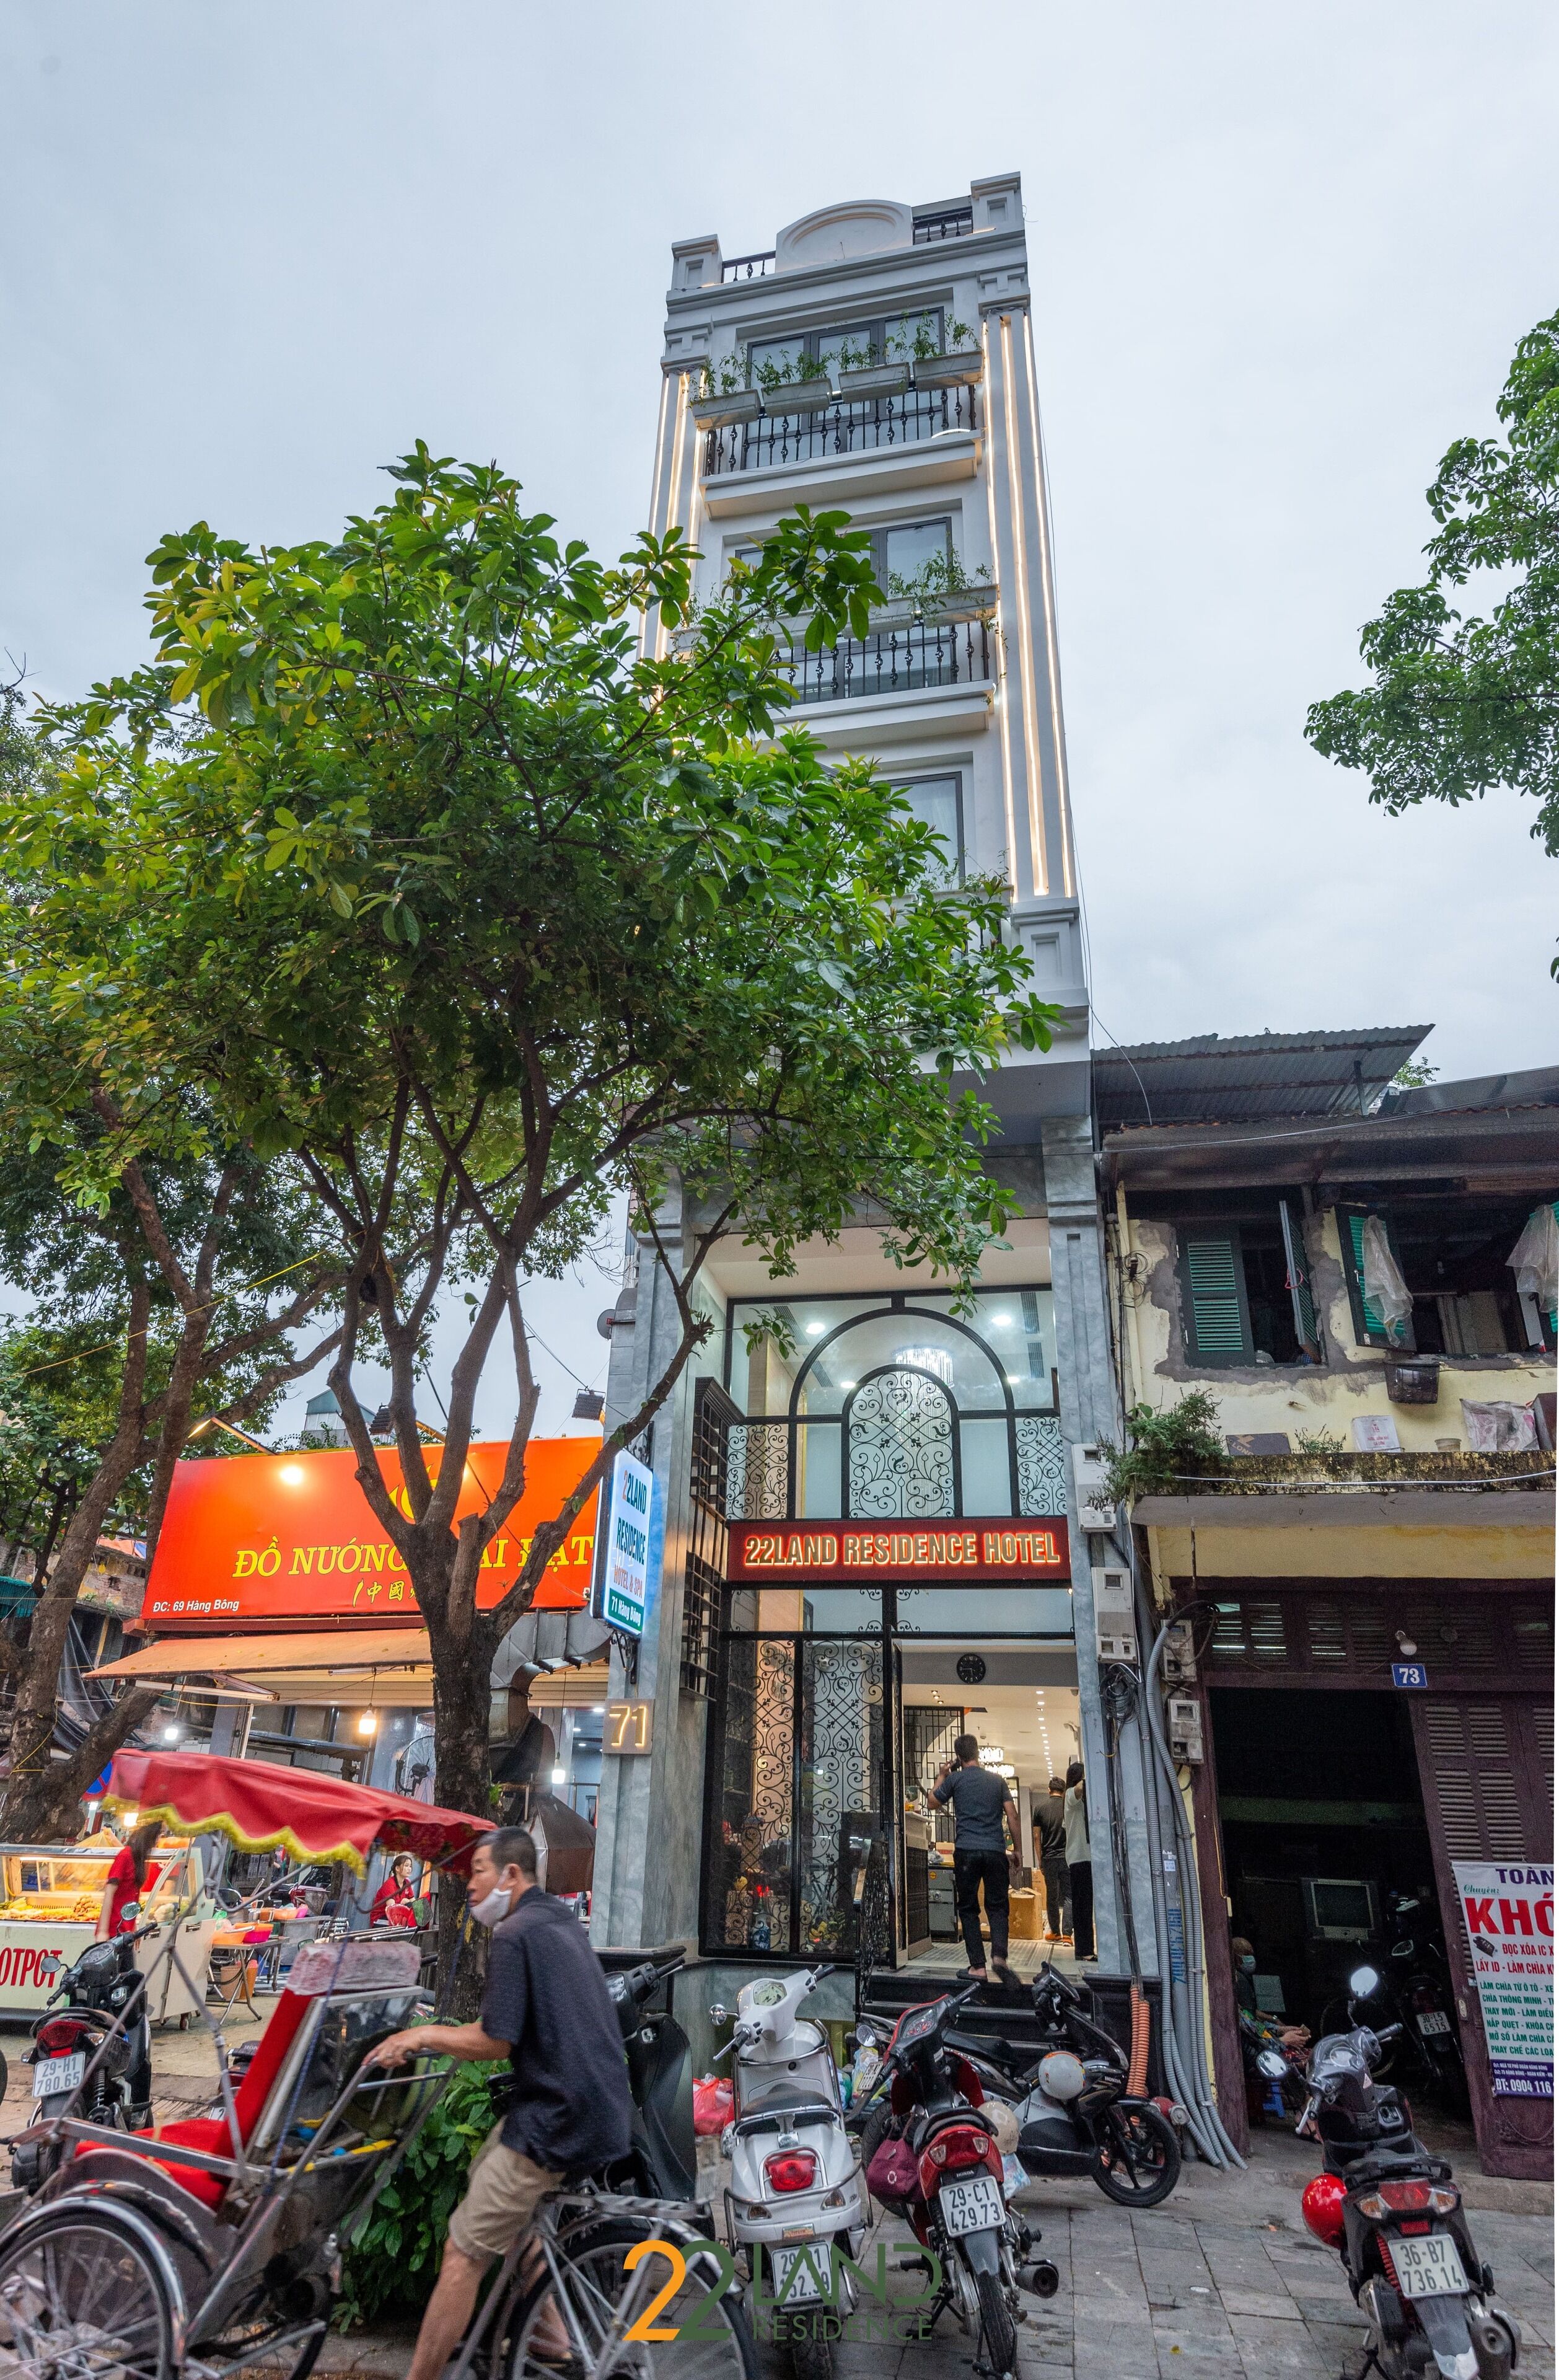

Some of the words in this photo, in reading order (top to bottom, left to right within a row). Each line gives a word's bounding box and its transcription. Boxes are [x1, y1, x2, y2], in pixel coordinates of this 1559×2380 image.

[621, 1470, 647, 1515] 22LAND
[616, 1517, 646, 1566] RESIDENCE
[744, 1534, 838, 1566] 22LAND
[843, 1532, 977, 1565] RESIDENCE
[983, 1532, 1060, 1564] HOTEL
[232, 1535, 283, 1577] ĐỒ
[288, 1536, 408, 1576] NƯỚNG
[613, 1564, 628, 1594] HOTEL
[635, 1579, 643, 1599] SPA
[153, 1601, 171, 1612] ĐC:
[173, 1600, 185, 1611] 69
[186, 1600, 211, 1613] Hàng
[213, 1598, 240, 1612] Bông
[612, 1596, 618, 1613] 71
[618, 1596, 630, 1621] Hàng
[1399, 1667, 1420, 1684] 73
[608, 1706, 648, 1747] 71
[1495, 1867, 1553, 1885] TOÀN
[1464, 1884, 1500, 1895] Chuyên:
[1502, 1943, 1518, 1956] ĐỌC
[1521, 1942, 1537, 1955] XÓA
[1538, 1945, 1547, 1955] IC
[1493, 1961, 1500, 1972] ID
[1507, 1960, 1525, 1973] LÀM
[1526, 1960, 1545, 1974] CHÌA
[1480, 1981, 1493, 1990] LÀM
[1496, 1981, 1511, 1991] CHÌA
[1482, 1994, 1497, 2003] CHÌA
[1499, 1995, 1522, 2004] THÔNG
[1524, 1996, 1542, 2004] MINH
[1484, 2007, 1499, 2015] THAY
[1522, 2008, 1537, 2017] LÀM
[1526, 2021, 1544, 2030] KHÓA
[1529, 2033, 1545, 2043] CHÌA
[1491, 2045, 1507, 2053] PHAY
[42, 2056, 77, 2078] 29-H1
[37, 2071, 81, 2095] 780.65
[1104, 2076, 1122, 2084] HONDA
[1495, 2078, 1509, 2091] ĐT:
[1511, 2079, 1533, 2092] 0904
[1534, 2081, 1552, 2094] 116
[949, 2182, 990, 2208] 29-C1
[951, 2202, 1001, 2231] 429.73
[1400, 2240, 1445, 2266] 36-B7
[1403, 2265, 1462, 2293] 736.14
